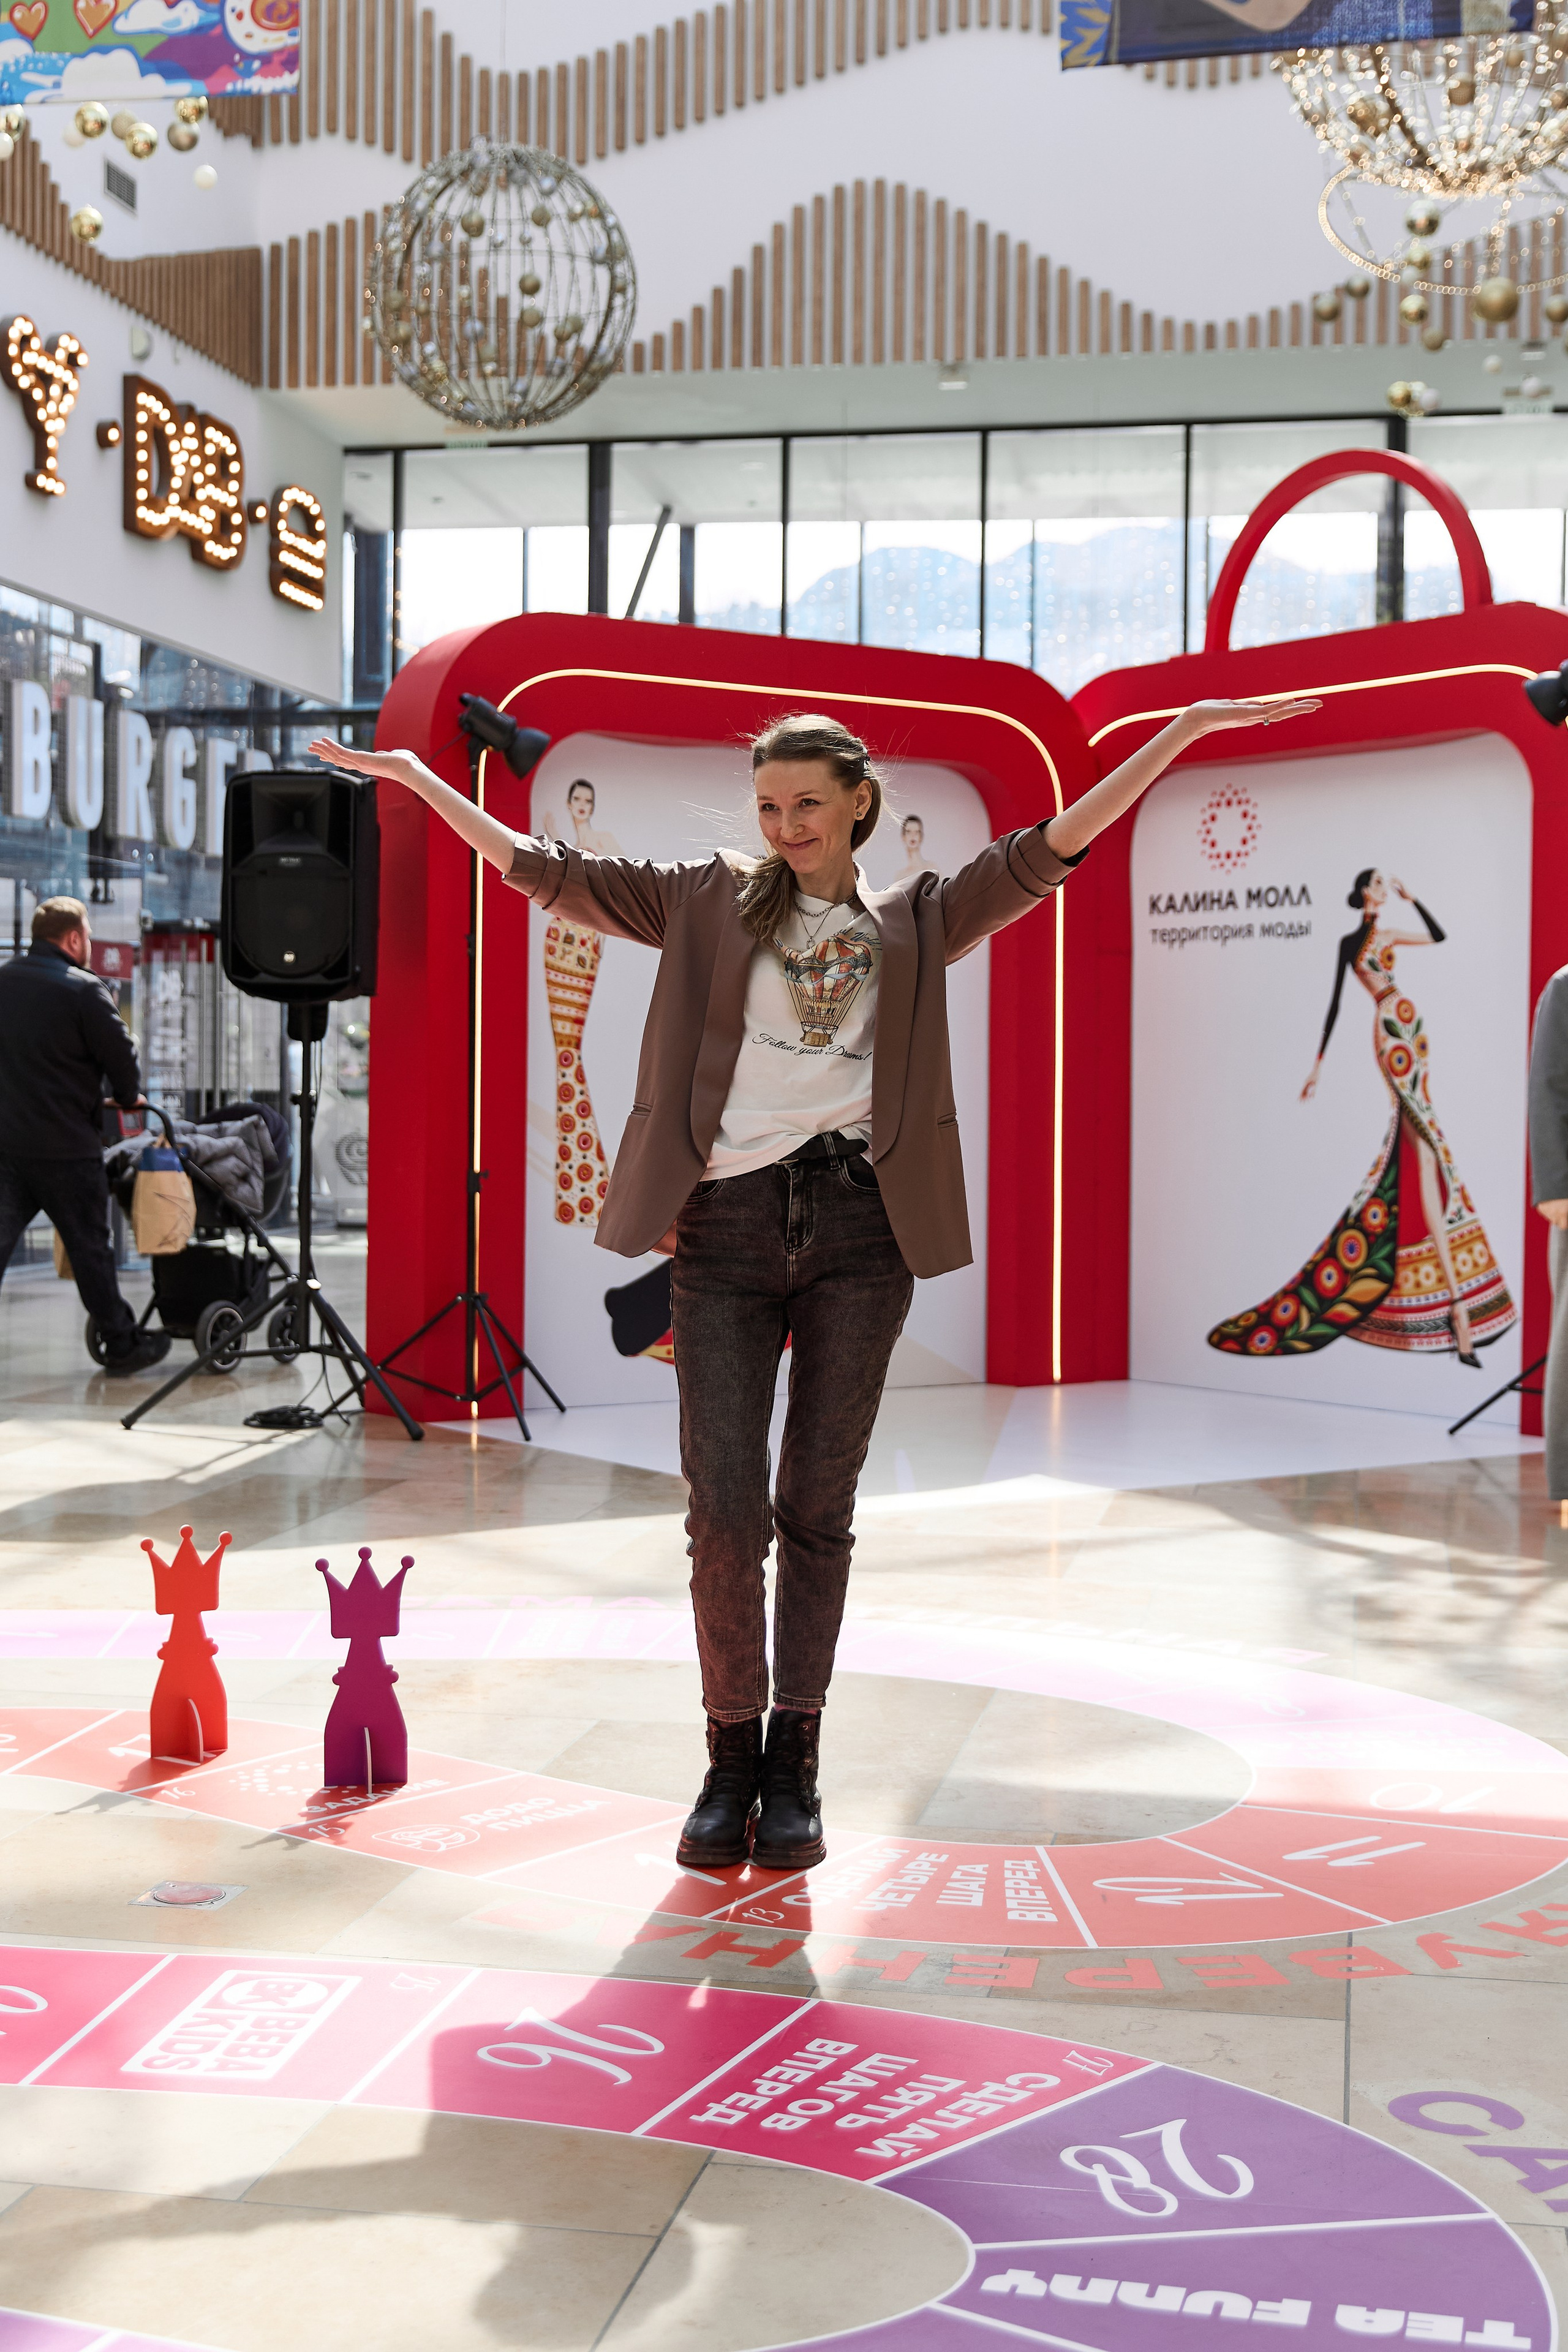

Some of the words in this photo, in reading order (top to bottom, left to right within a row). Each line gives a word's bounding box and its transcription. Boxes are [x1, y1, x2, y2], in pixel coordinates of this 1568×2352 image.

[10, 677, 306, 857] BURGE
[1149, 888, 1238, 914] КАЛИНА
[1245, 883, 1313, 908] МОЛЛ
[1150, 923, 1254, 949] территория
[1259, 919, 1312, 940] моды
[752, 1033, 797, 1052] Follow
[794, 1045, 824, 1056] your
[824, 1044, 873, 1061] Dreams!
[160, 1787, 196, 1800] 16
[306, 1778, 450, 1814] ЗАДАНИЕ
[459, 1796, 556, 1824] ДОДО
[486, 1800, 612, 1831] ПИЦЦА
[309, 1823, 345, 1838] 15
[782, 1847, 910, 1906] СДЕЛАЙ
[853, 1852, 949, 1911] ЧЕТЫРЕ
[936, 1864, 989, 1906] ШАГА
[1005, 1859, 1058, 1922] ВПЕРЕД
[1093, 1871, 1284, 1906] 12
[742, 1907, 785, 1923] 13
[141, 2012, 247, 2071] KIDS
[477, 2007, 665, 2086] 26
[1061, 2049, 1115, 2076] 27
[689, 2038, 859, 2126] ВПЕРЕД
[760, 2052, 919, 2131] ШАГОВ
[835, 2073, 967, 2128] ПЯТЬ
[855, 2071, 1061, 2159] СДЕЛАЙ
[1060, 2118, 1254, 2217] 28
[1335, 2303, 1531, 2350] TEA
